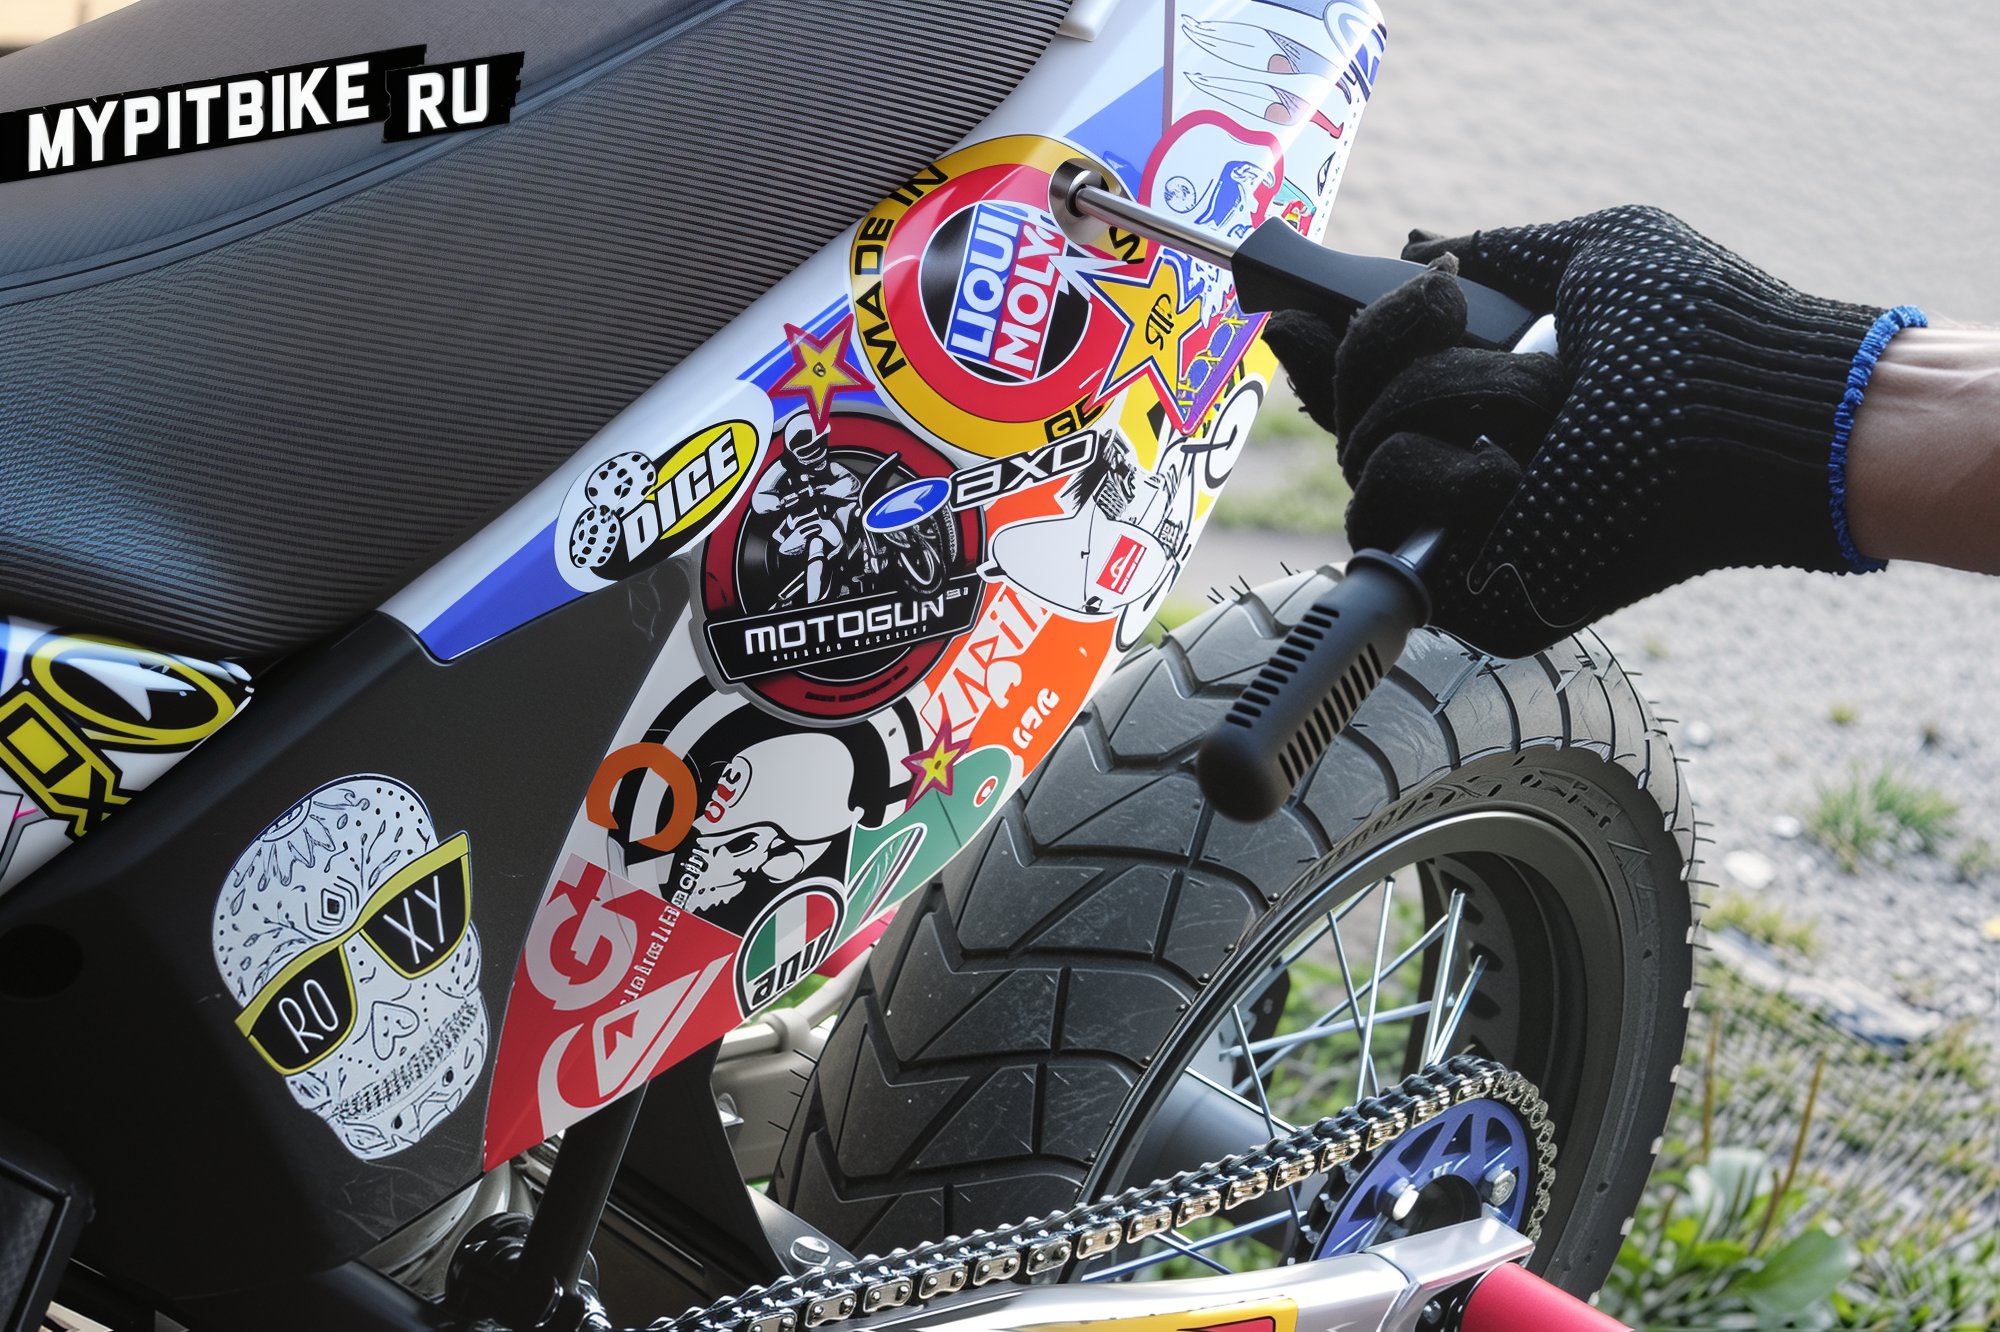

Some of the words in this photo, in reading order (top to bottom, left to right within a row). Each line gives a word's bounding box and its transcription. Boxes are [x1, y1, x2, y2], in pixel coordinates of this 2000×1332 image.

[854, 217, 907, 379] MADE
[889, 165, 949, 207] IN
[950, 211, 1021, 359] LIQUI
[994, 224, 1061, 372] MOLY
[619, 427, 741, 562] DICE
[744, 594, 945, 656] MOTOGUN
